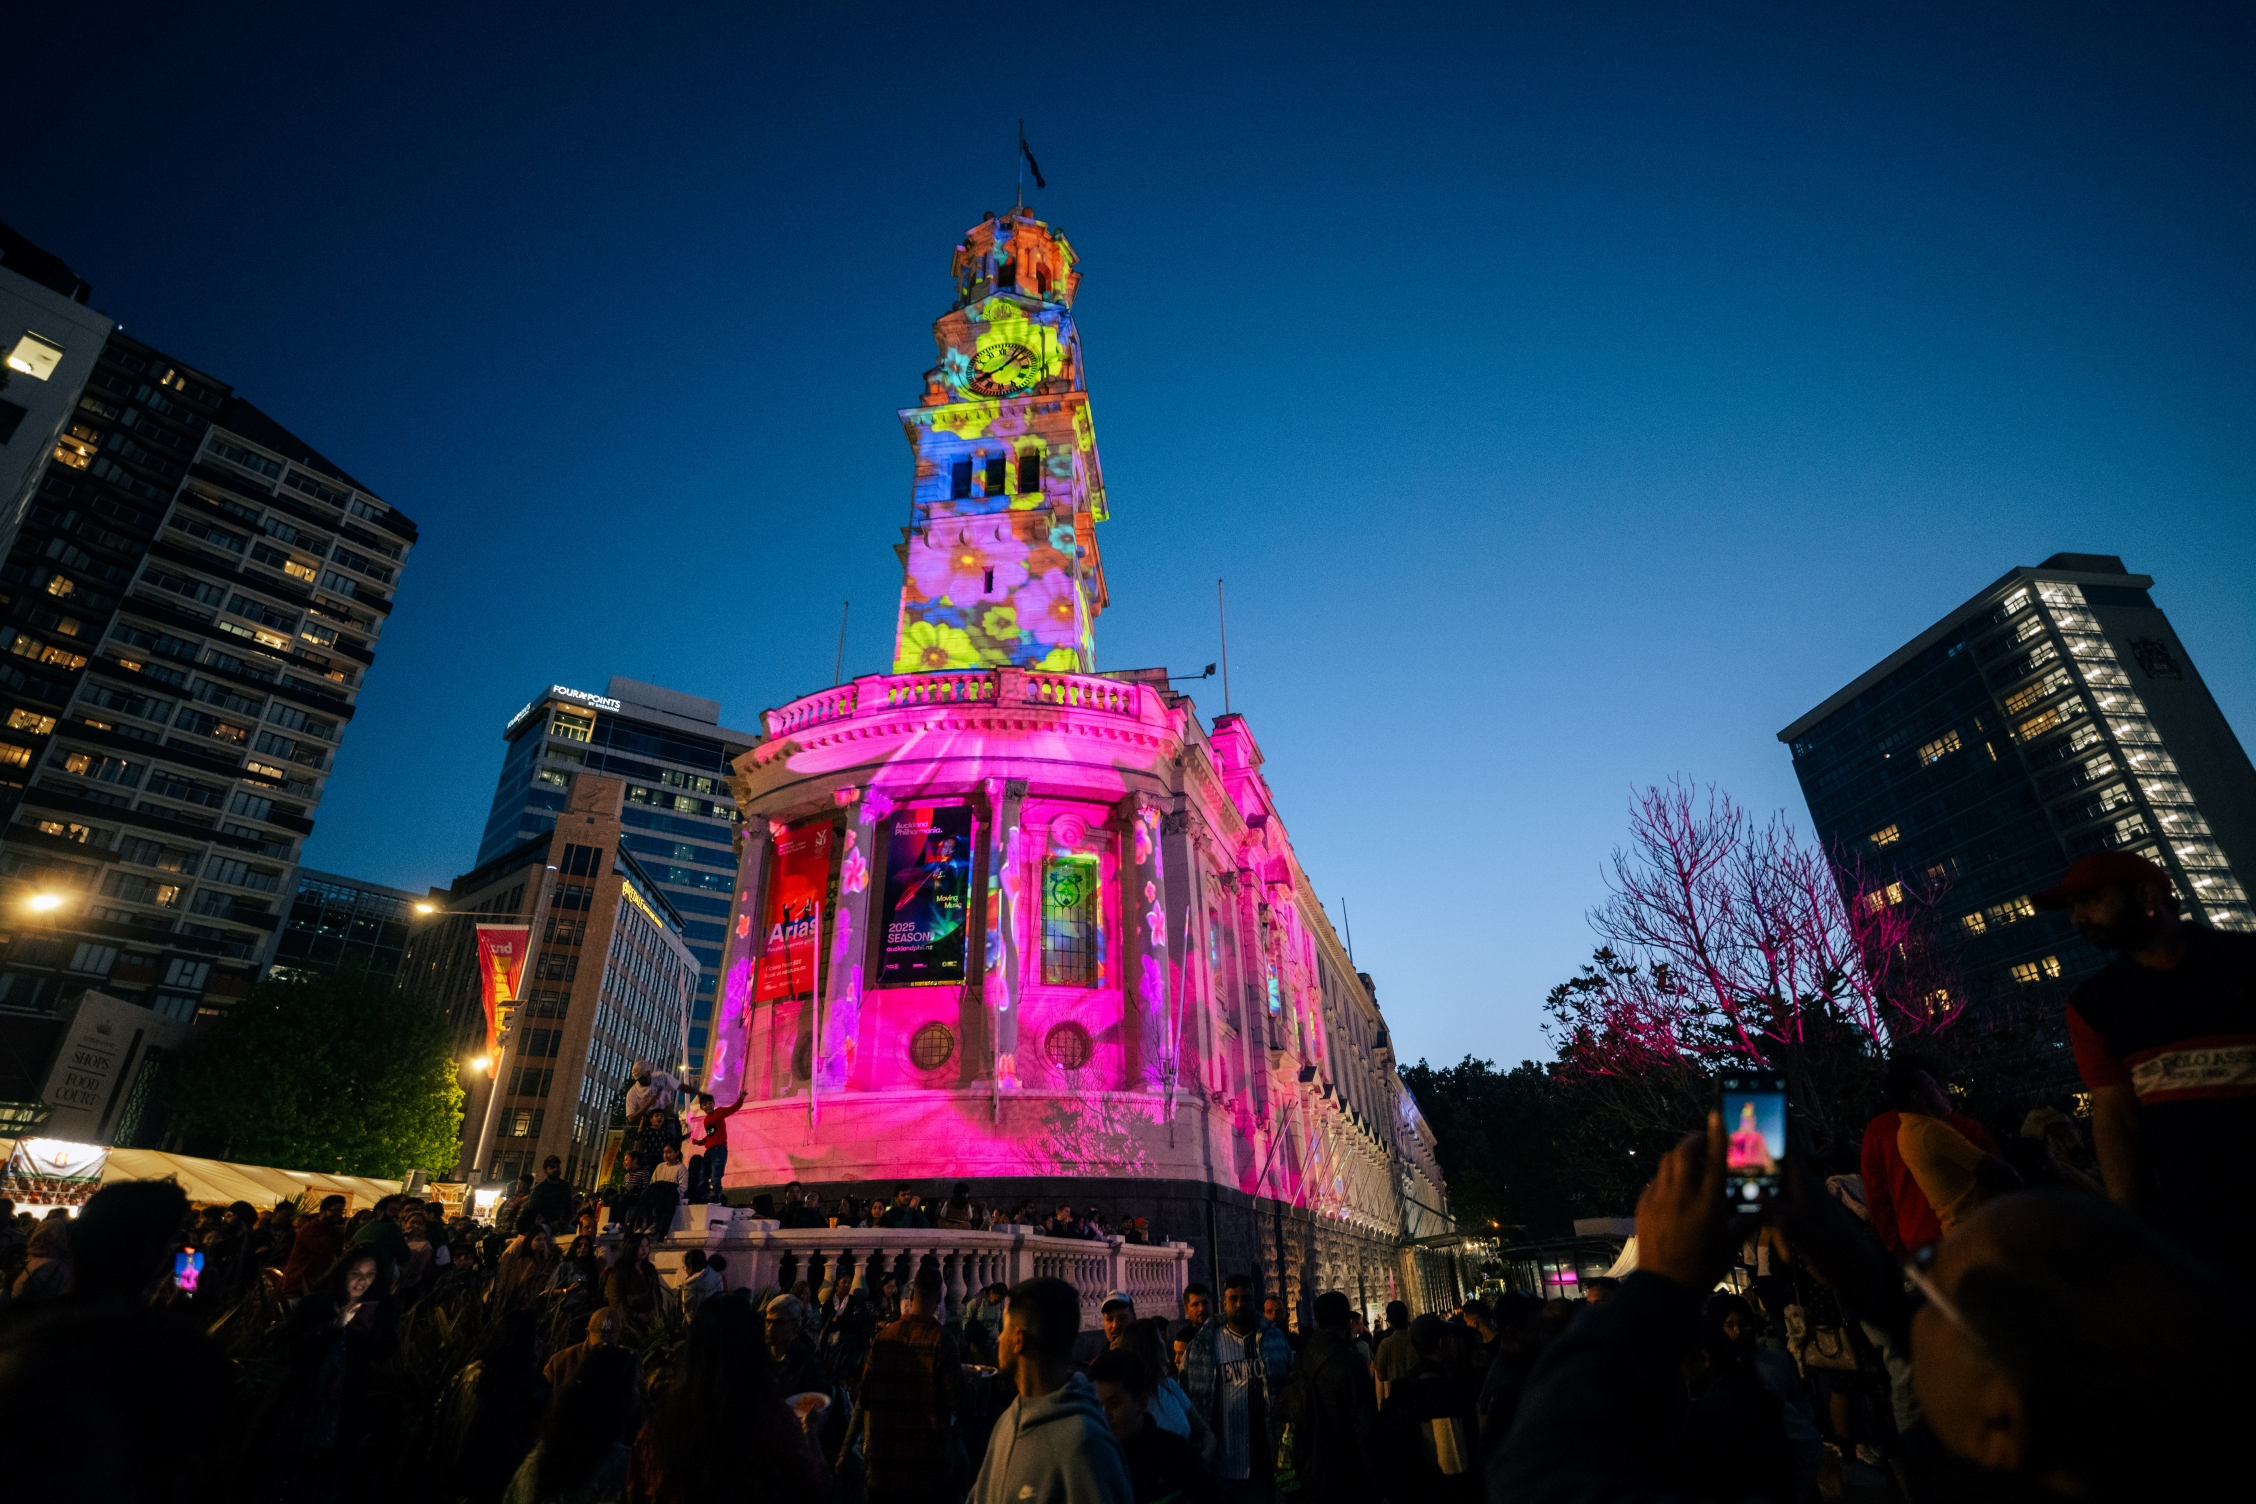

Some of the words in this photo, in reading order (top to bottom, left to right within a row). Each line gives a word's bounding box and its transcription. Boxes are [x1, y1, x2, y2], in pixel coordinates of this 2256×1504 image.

[552, 684, 579, 699] FOUR
[587, 692, 621, 709] POINTS
[895, 820, 929, 829] Auckland
[936, 893, 960, 904] Moving
[943, 902, 963, 910] Music
[768, 917, 816, 945] Arias
[888, 921, 916, 933] 2025
[886, 931, 931, 944] SEASON
[885, 944, 934, 953] aucklandphil.nz
[72, 1050, 111, 1071] SHOPS
[65, 1072, 101, 1091] FOOD
[54, 1087, 99, 1106] COURT
